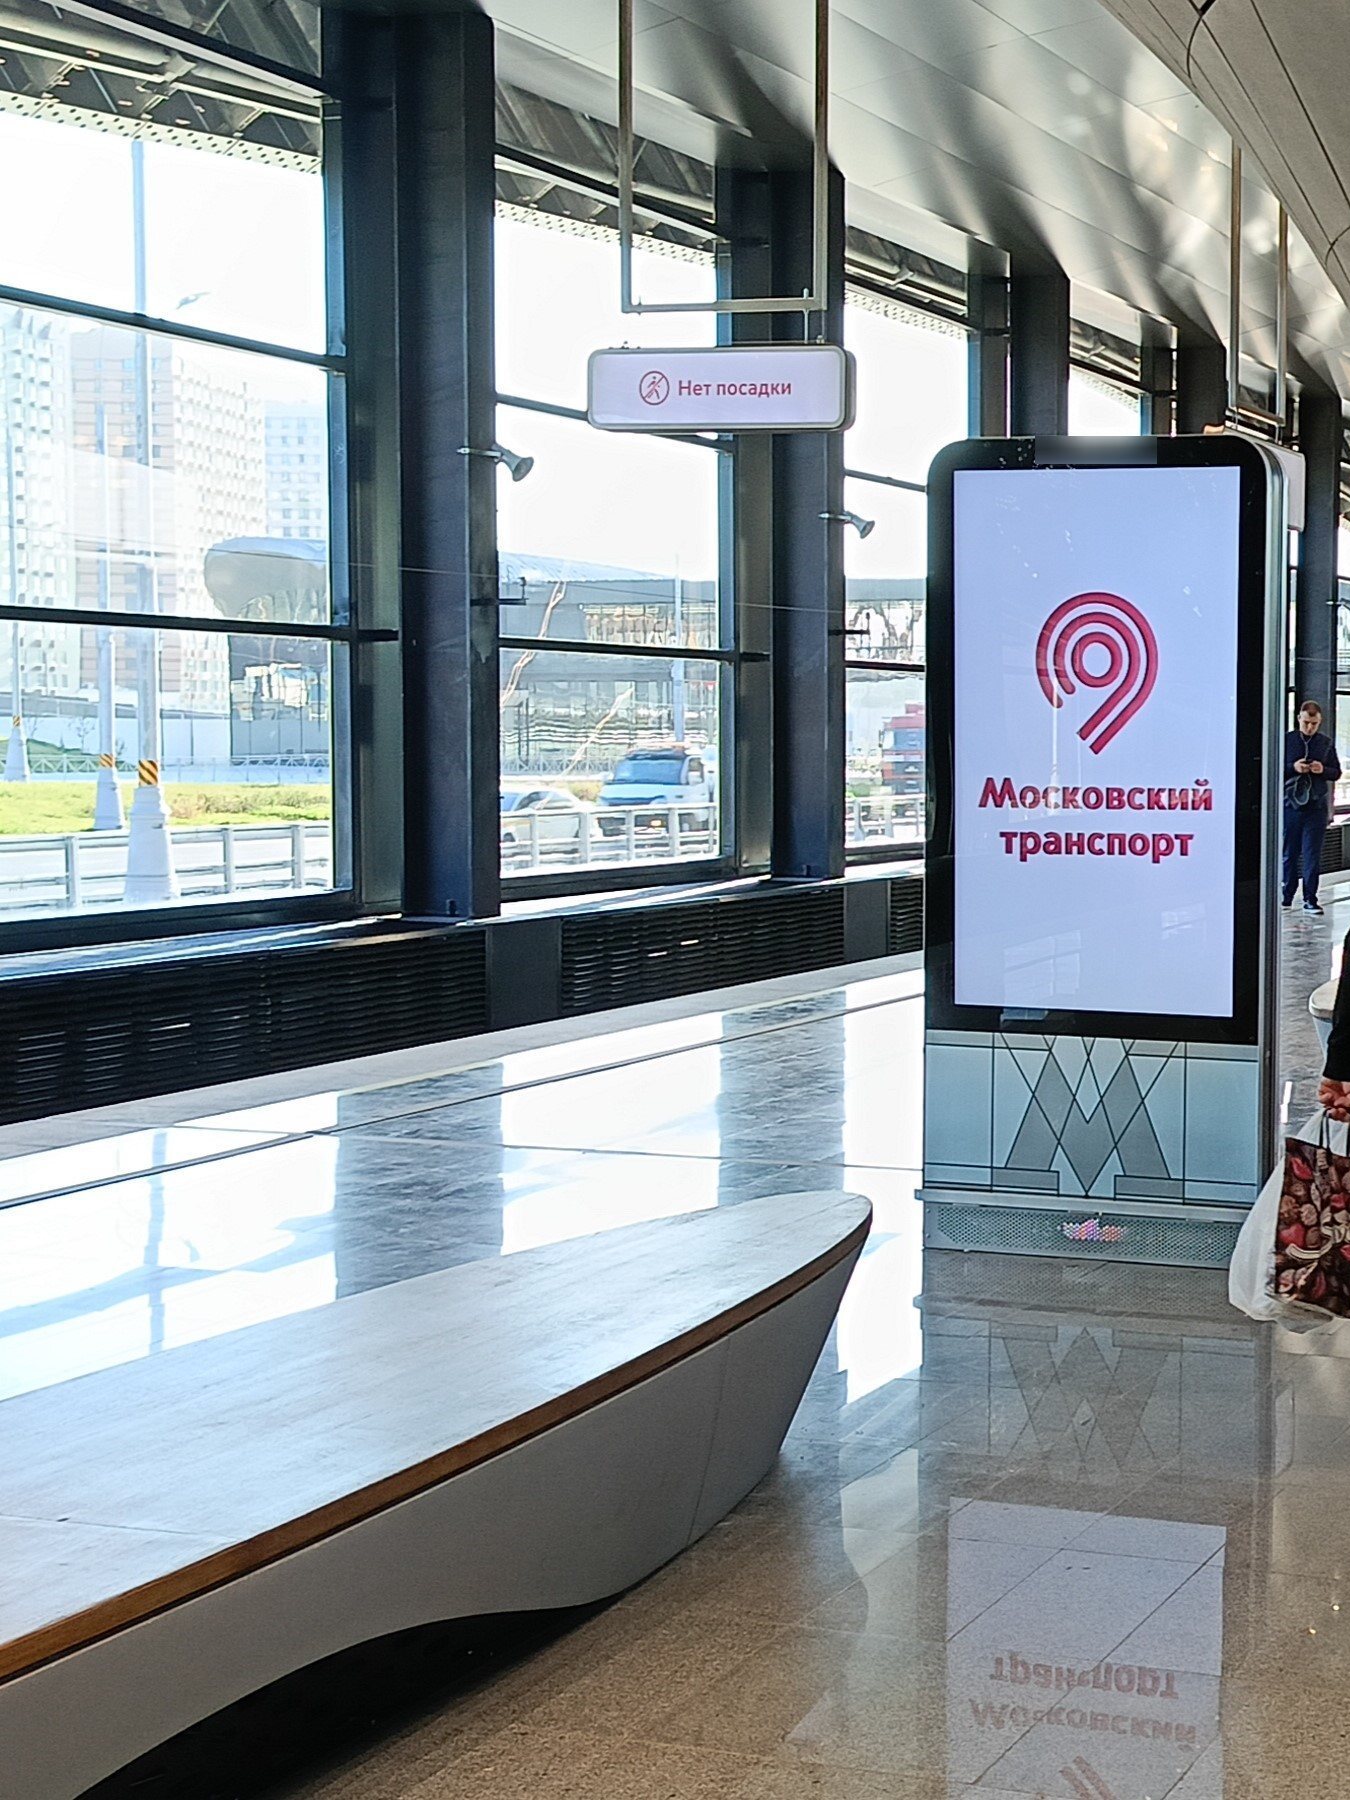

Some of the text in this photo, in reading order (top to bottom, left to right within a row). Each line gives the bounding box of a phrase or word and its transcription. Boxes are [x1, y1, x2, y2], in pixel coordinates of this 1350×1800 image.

[678, 380, 791, 398] Нет посадки
[978, 776, 1213, 811] Московский
[999, 830, 1194, 864] транспорт
